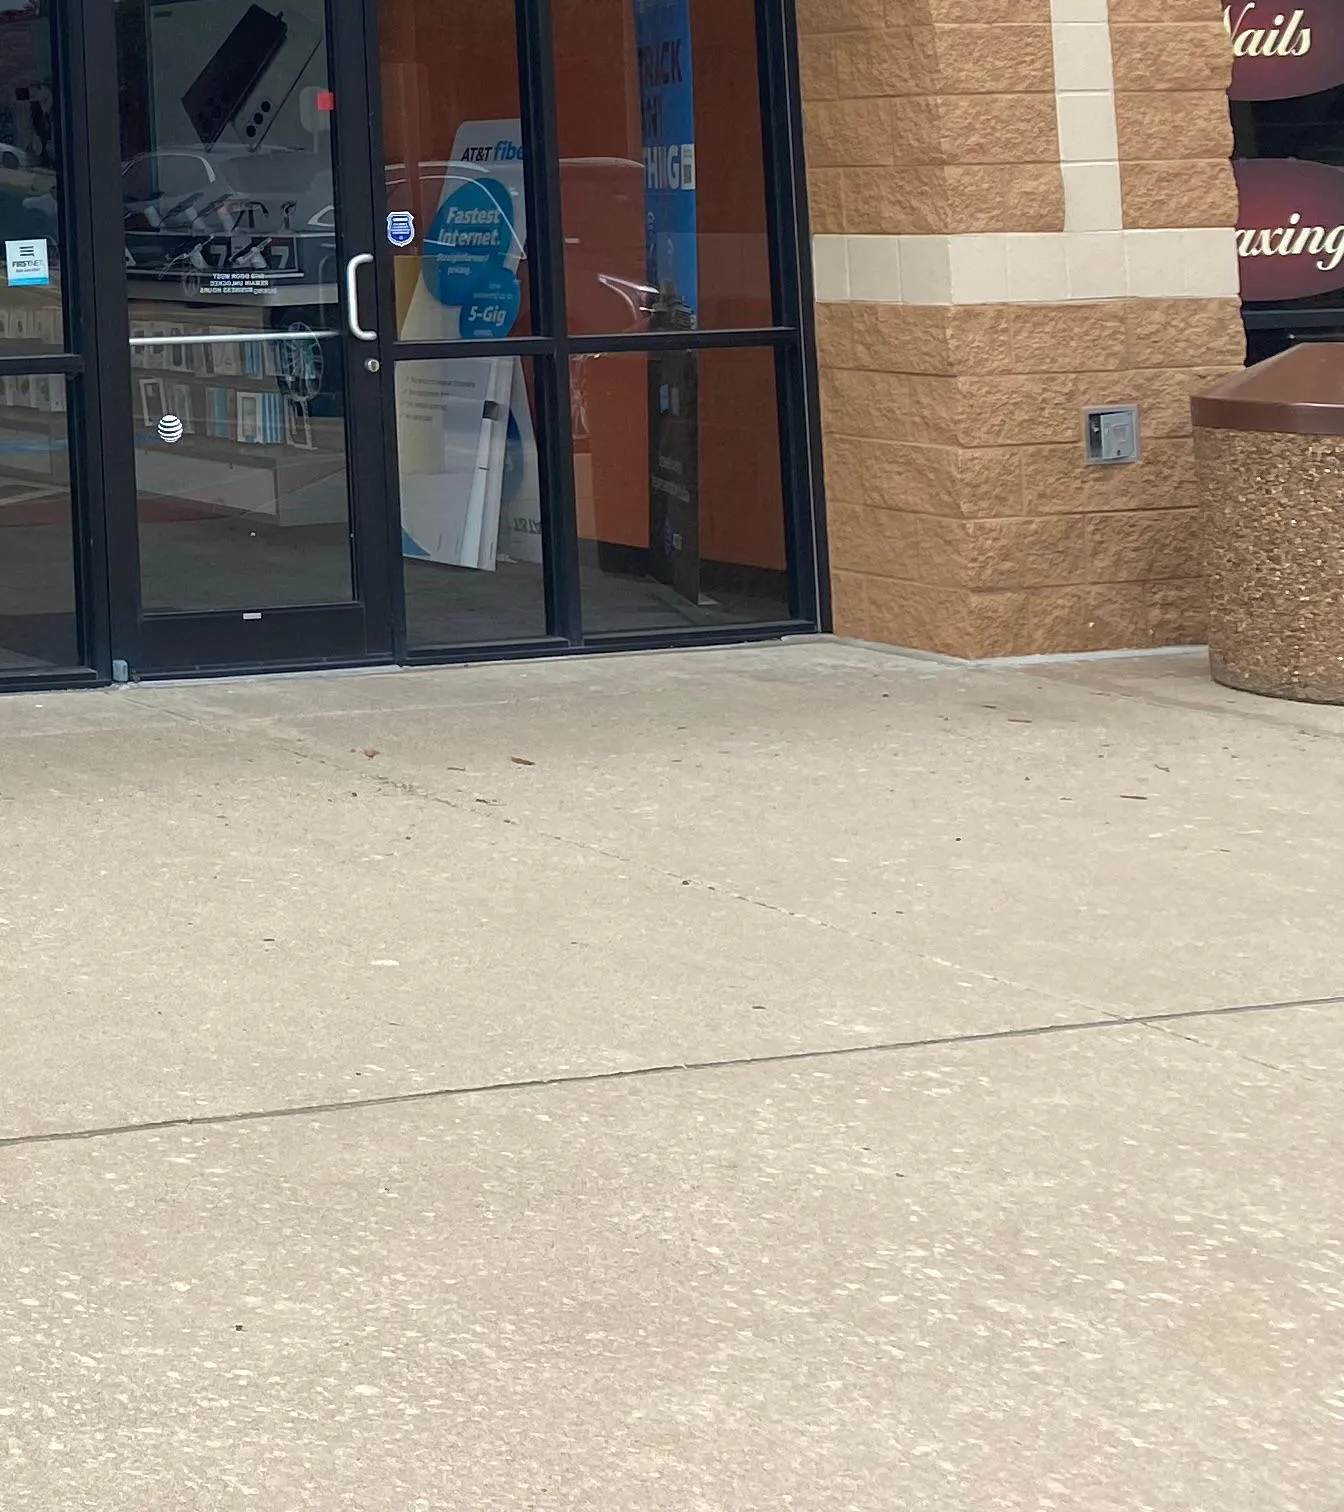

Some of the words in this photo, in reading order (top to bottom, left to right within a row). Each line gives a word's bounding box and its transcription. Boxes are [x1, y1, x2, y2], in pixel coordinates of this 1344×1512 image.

[461, 147, 492, 162] AT&T
[493, 141, 524, 161] fibe
[446, 207, 500, 224] Fastest
[438, 227, 500, 247] Internet.
[1235, 213, 1344, 271] axing
[468, 305, 507, 327] 5-Gig
